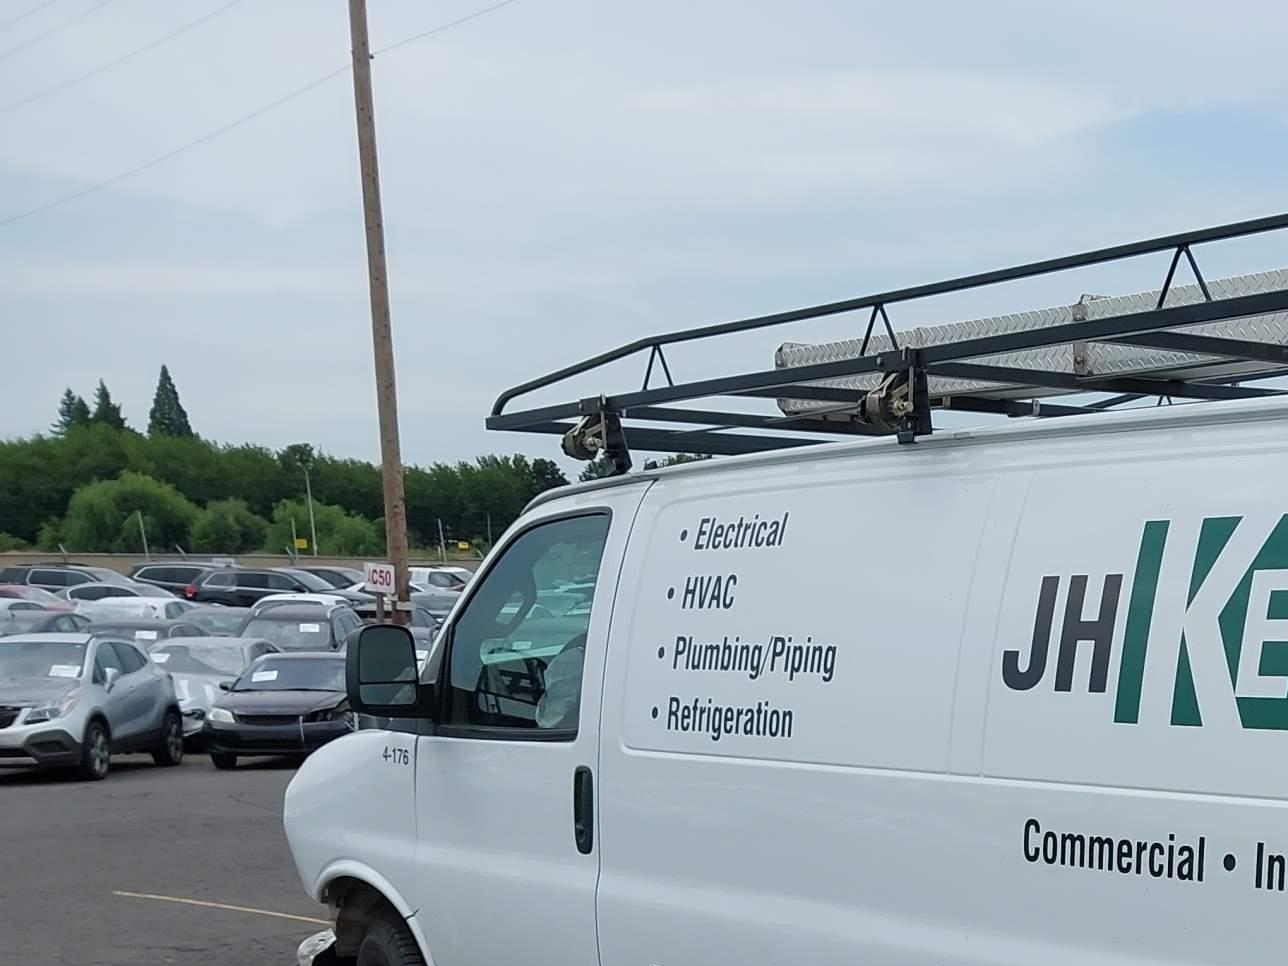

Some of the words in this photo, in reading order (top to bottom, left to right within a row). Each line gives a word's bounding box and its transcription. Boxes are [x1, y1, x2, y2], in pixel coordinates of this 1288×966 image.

[694, 512, 789, 550] Electrical
[681, 574, 737, 609] HVAC
[672, 635, 837, 682] Plumbing/Piping
[666, 696, 793, 741] Refrigeration
[382, 745, 409, 766] 4-176
[1022, 818, 1206, 882] Commercial
